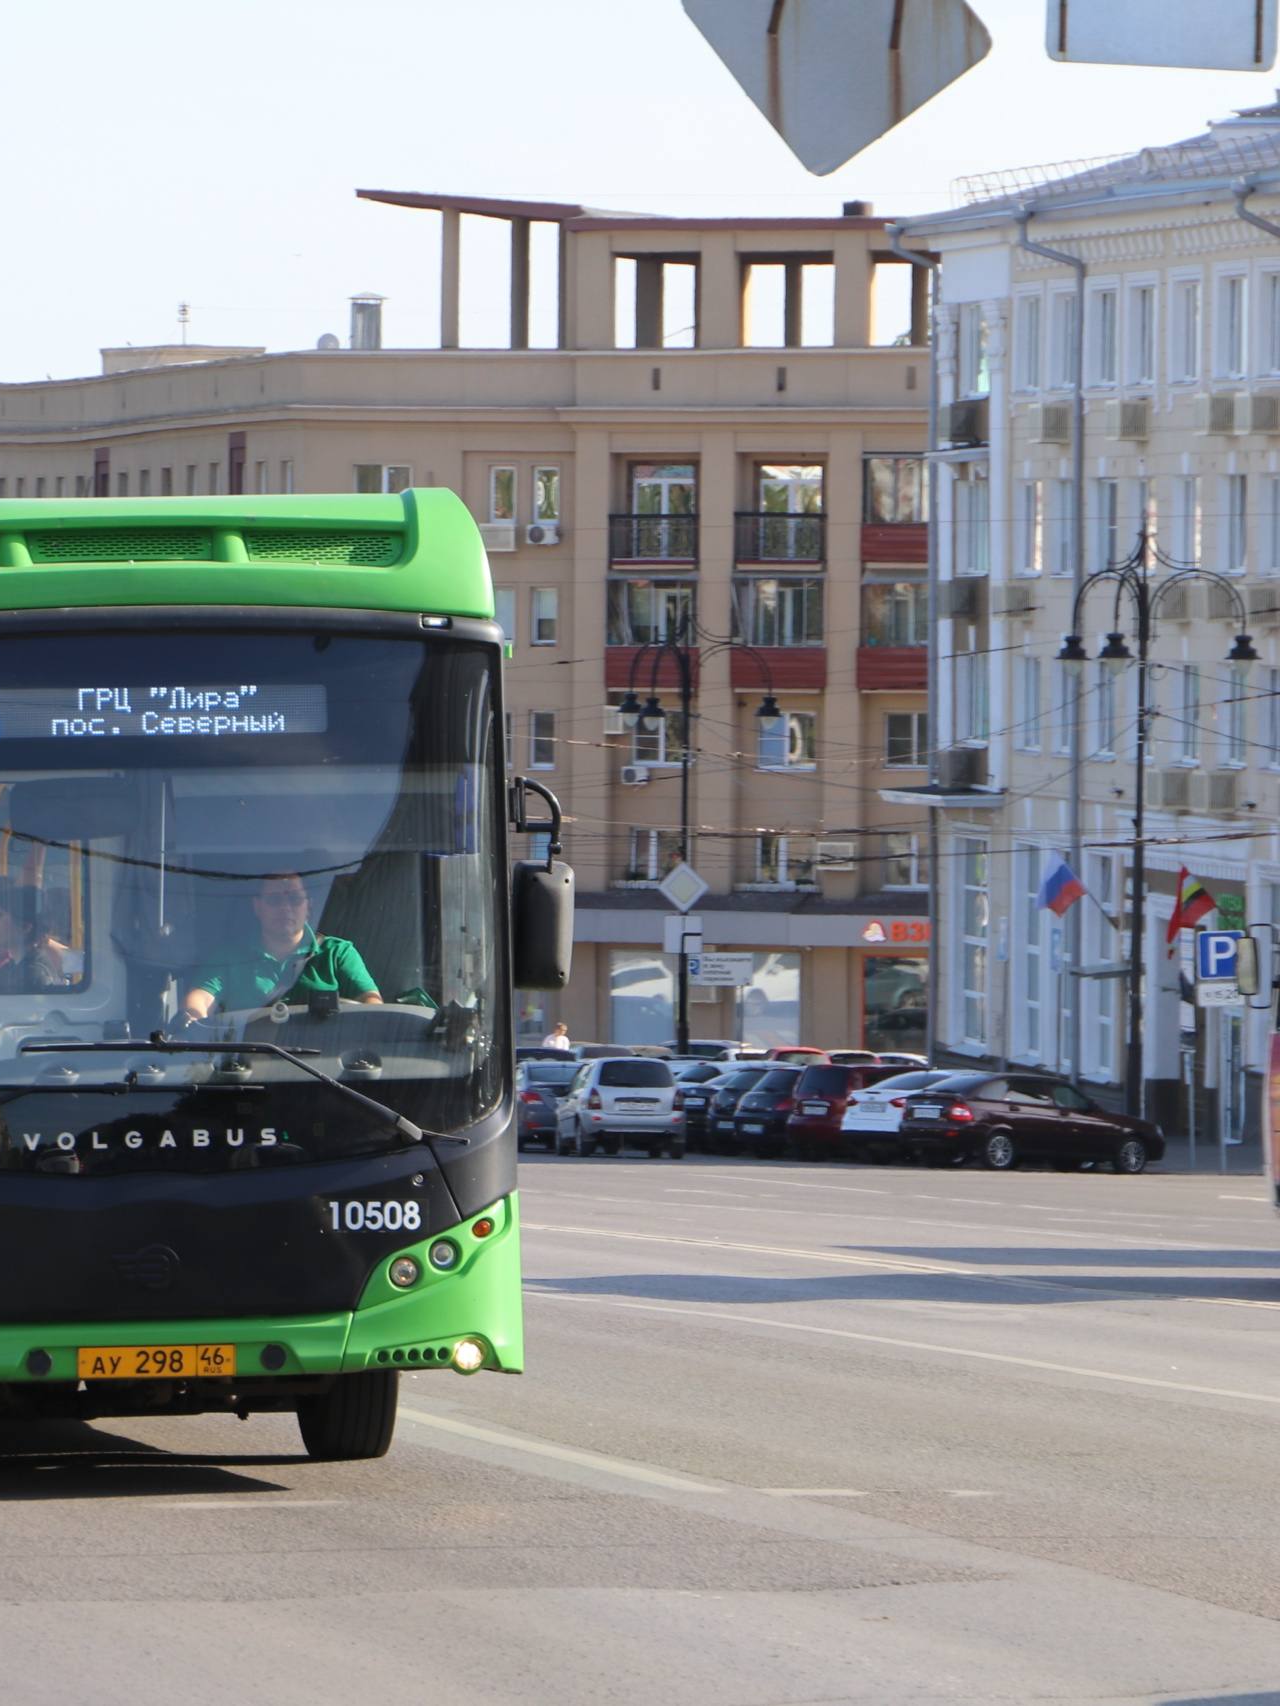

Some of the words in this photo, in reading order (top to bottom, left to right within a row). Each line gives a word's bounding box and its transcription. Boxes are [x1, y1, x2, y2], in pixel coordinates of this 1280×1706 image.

[78, 687, 131, 713] ГРЦ
[51, 717, 120, 735] пос.
[142, 711, 286, 736] Северный
[1208, 936, 1238, 975] P
[23, 1128, 277, 1150] VOLGABUS
[329, 1201, 421, 1231] 10508
[92, 1356, 122, 1375] АУ
[135, 1350, 184, 1374] 298
[200, 1347, 225, 1365] 46
[203, 1366, 223, 1374] RUS
